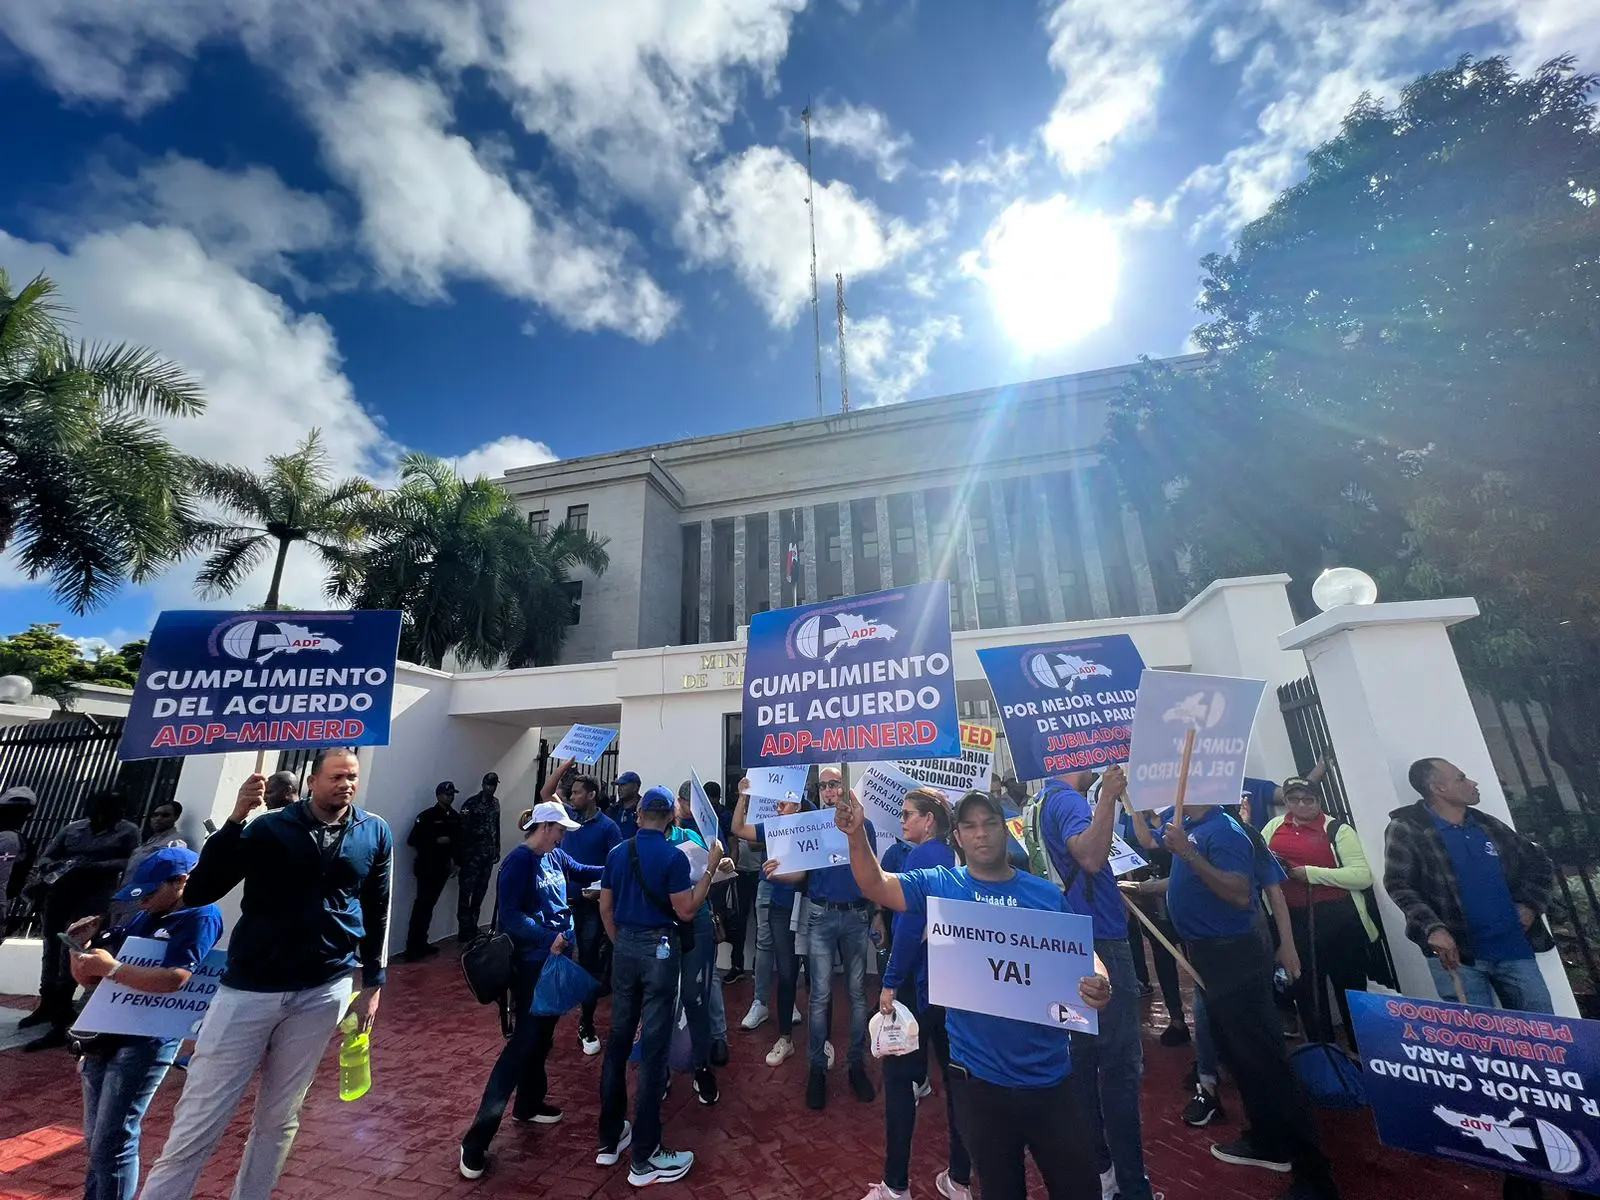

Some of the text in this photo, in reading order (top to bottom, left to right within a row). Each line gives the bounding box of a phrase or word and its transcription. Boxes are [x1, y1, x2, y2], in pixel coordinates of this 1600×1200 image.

[292, 639, 321, 648] ADP
[852, 627, 877, 640] ADP
[701, 652, 748, 669] MINI
[1079, 665, 1097, 676] ADP
[146, 667, 387, 690] CUMPLIMIENTO
[682, 673, 709, 690] DE
[749, 652, 949, 698] CUMPLIMIENTO
[153, 693, 373, 718] DEL ACUERDO
[757, 686, 940, 726] DEL ACUERDO
[1003, 689, 1139, 719] POR MEJOR CALID
[1037, 719, 1059, 733] DE
[1060, 711, 1102, 729] VIDA
[150, 719, 365, 748] ADP-MINERD
[760, 720, 938, 757] ADP-MINERD
[960, 725, 992, 746] TED
[961, 750, 990, 766] ARIAL
[1044, 743, 1131, 772] PENSIONA
[768, 772, 784, 785] YA!
[867, 767, 908, 794] AUMENTO
[980, 766, 987, 778] Y
[863, 790, 870, 799] Y
[866, 779, 905, 808] PARA JUB
[767, 821, 837, 838] AUMENTO SALARI
[797, 838, 820, 853] YA!
[1007, 896, 1018, 906] de
[932, 922, 1088, 956] AUMENTO SALARIAL
[119, 955, 163, 968] AUME
[988, 957, 1031, 986] YA!
[111, 992, 210, 1012] Y PENSIONAD
[1386, 1000, 1574, 1043] PENSIONADOS
[1403, 1022, 1567, 1064] JUBILADOS Y
[1401, 1043, 1584, 1091] DE VIDA PARA
[1369, 1058, 1600, 1117] R MEJOR CALIDAD
[1460, 1118, 1492, 1132] ADP
